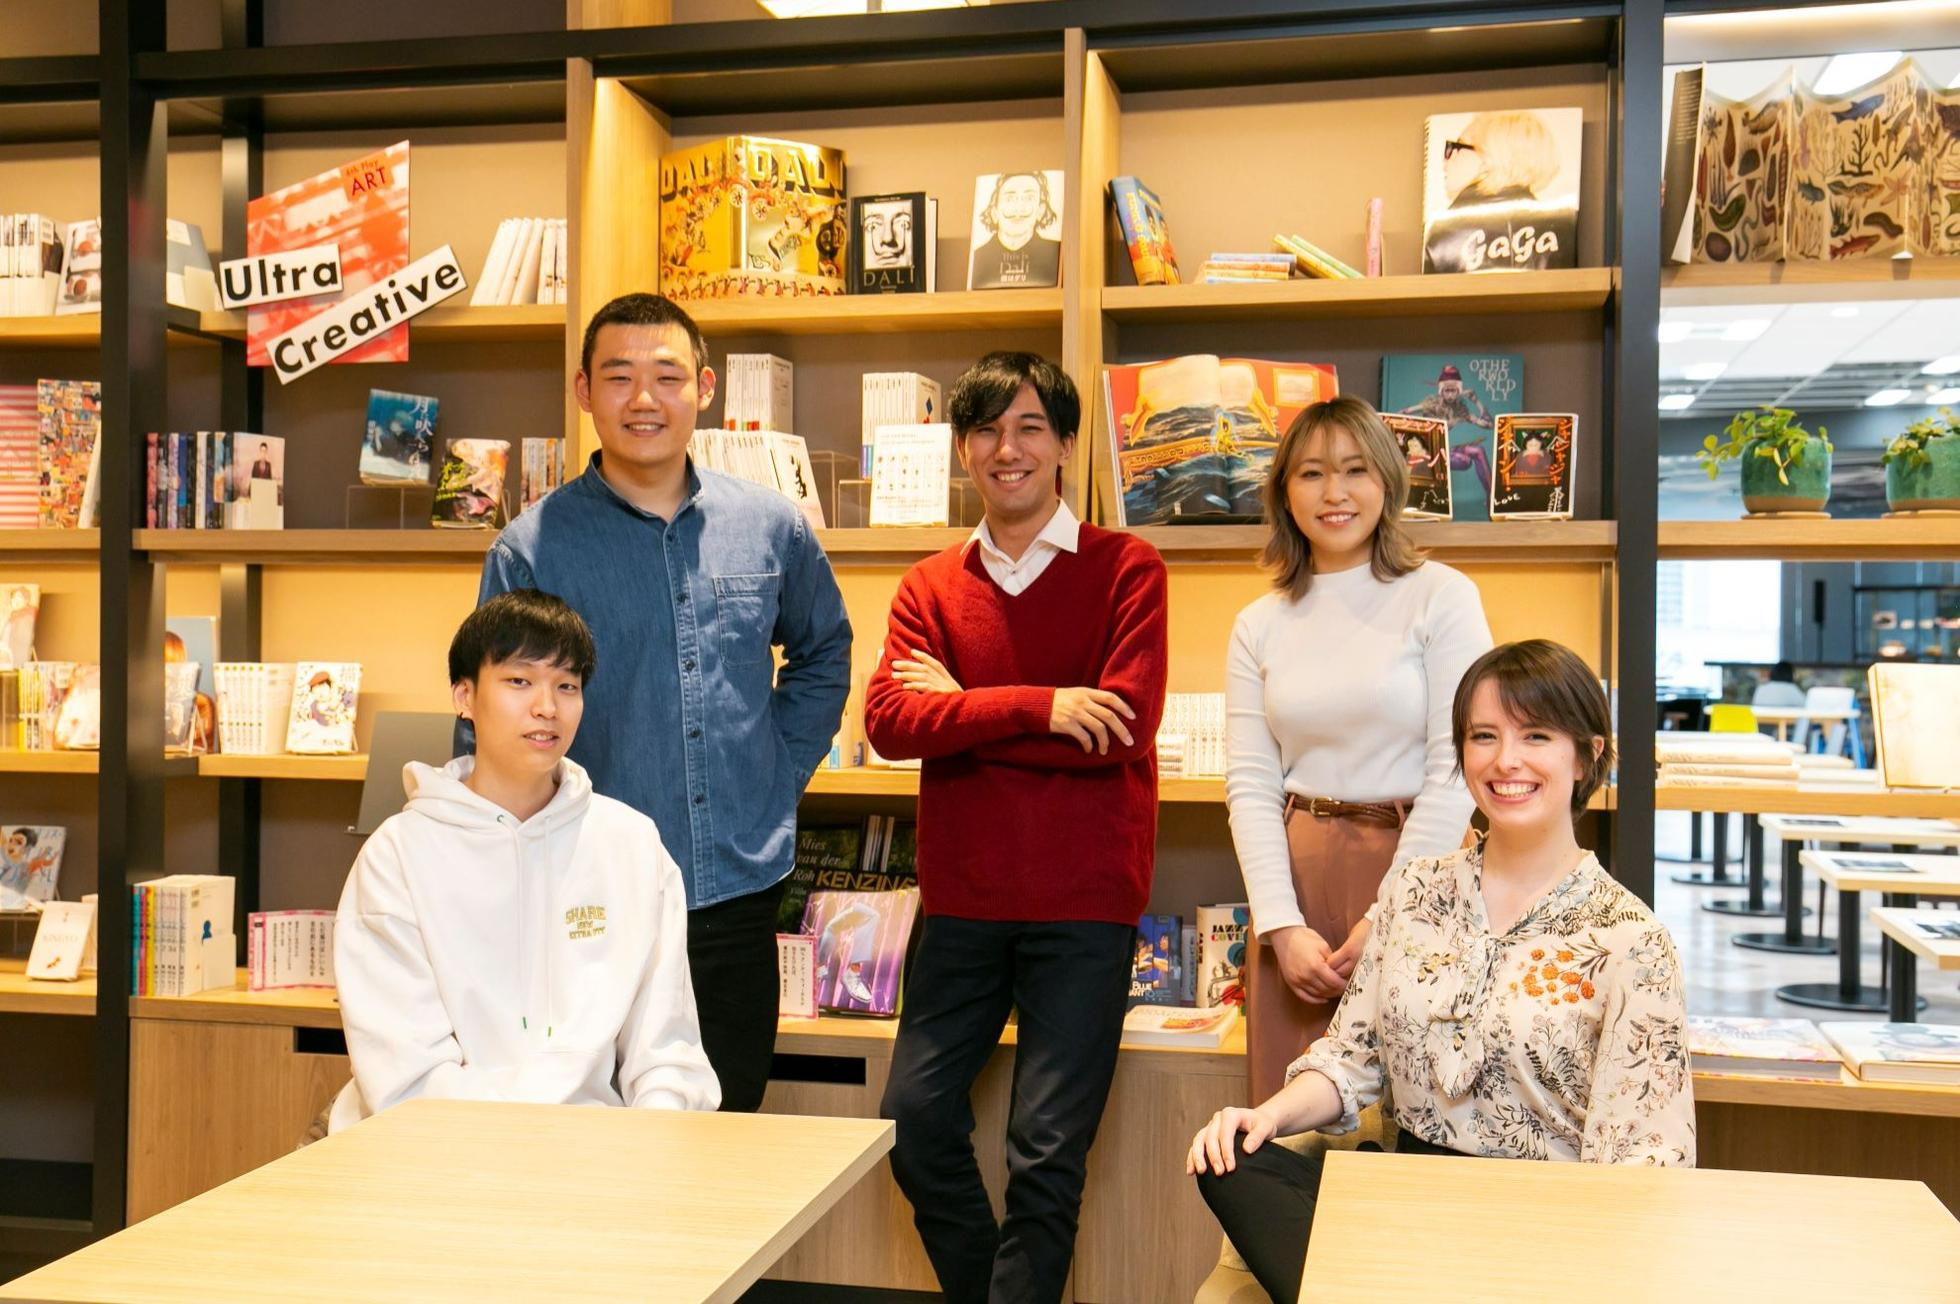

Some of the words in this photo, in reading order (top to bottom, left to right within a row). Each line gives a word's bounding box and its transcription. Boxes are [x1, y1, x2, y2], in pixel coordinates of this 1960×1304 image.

[352, 165, 386, 196] ART
[1461, 226, 1559, 270] GaGa
[223, 259, 339, 301] Ultra
[274, 263, 460, 374] Creative
[1469, 359, 1510, 372] OTHE
[800, 837, 827, 850] Mies
[1212, 925, 1244, 934] JAZZ
